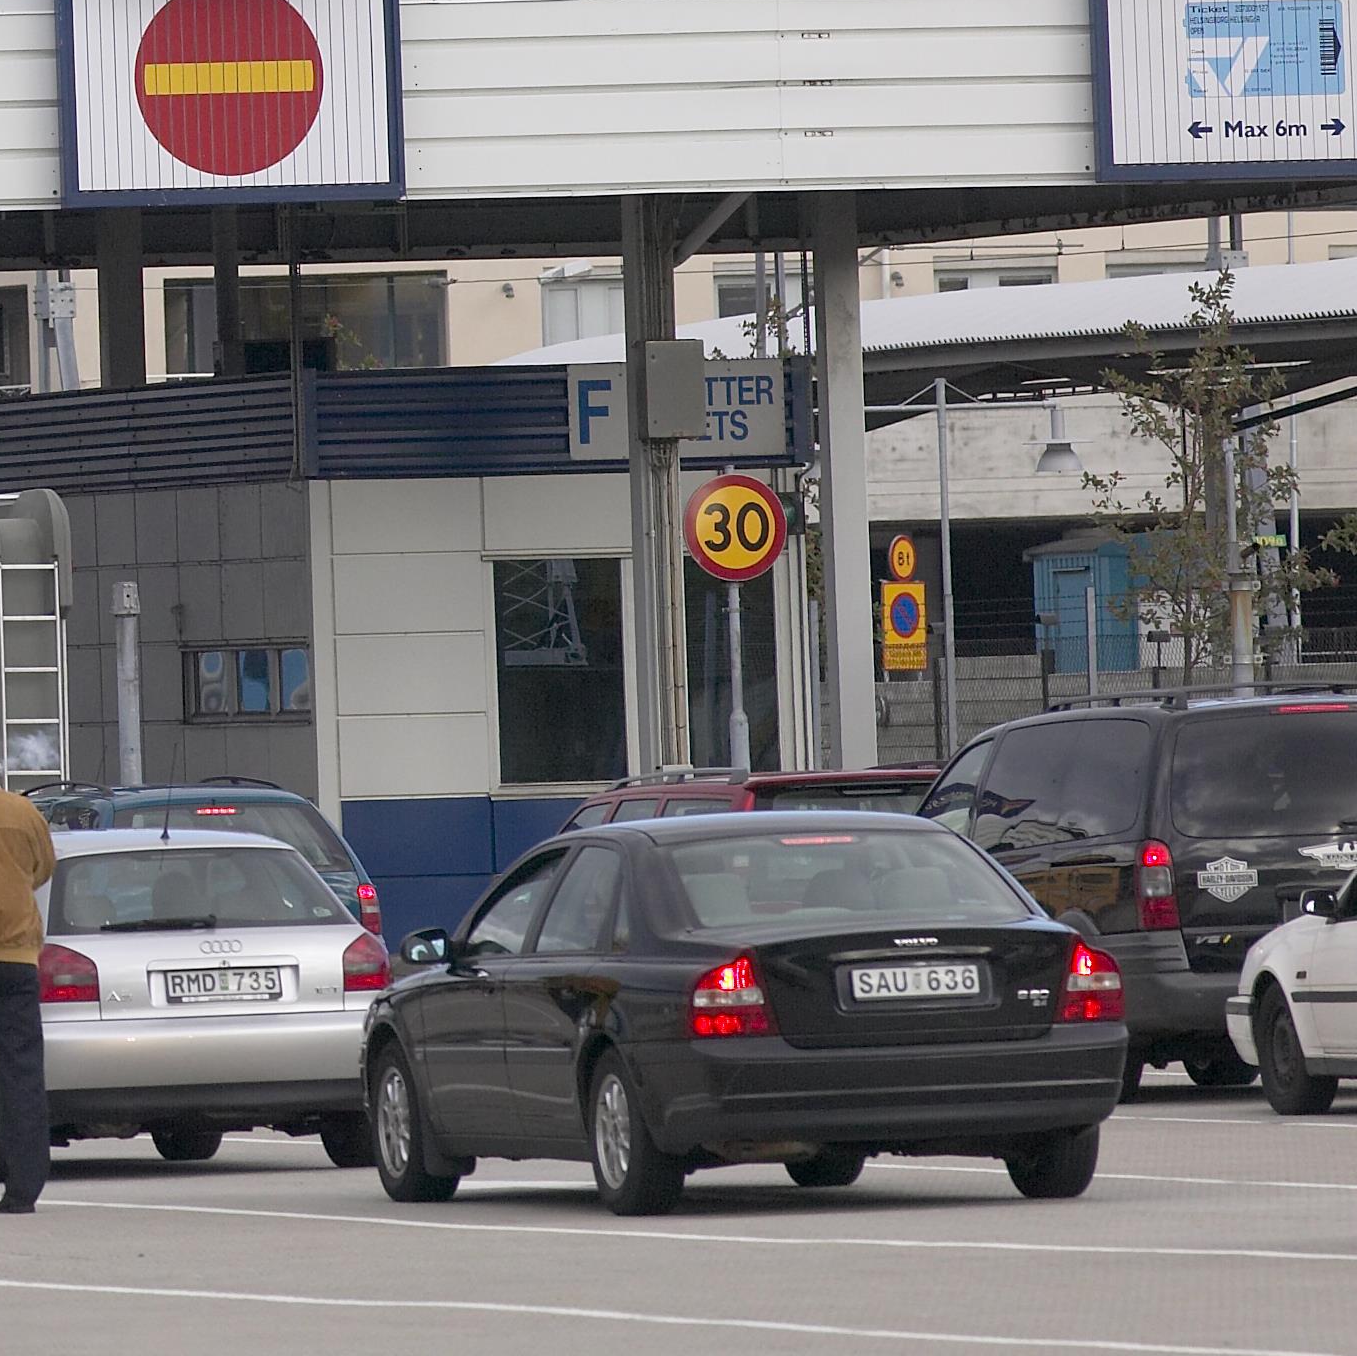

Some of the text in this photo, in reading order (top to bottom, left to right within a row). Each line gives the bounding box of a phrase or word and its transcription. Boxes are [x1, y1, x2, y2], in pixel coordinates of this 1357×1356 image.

[1225, 120, 1307, 138] Max 6m
[704, 375, 774, 406] TTER
[578, 380, 611, 445] F
[704, 502, 770, 552] 30
[171, 971, 277, 994] RMD 735
[859, 969, 976, 993] SAU 636
